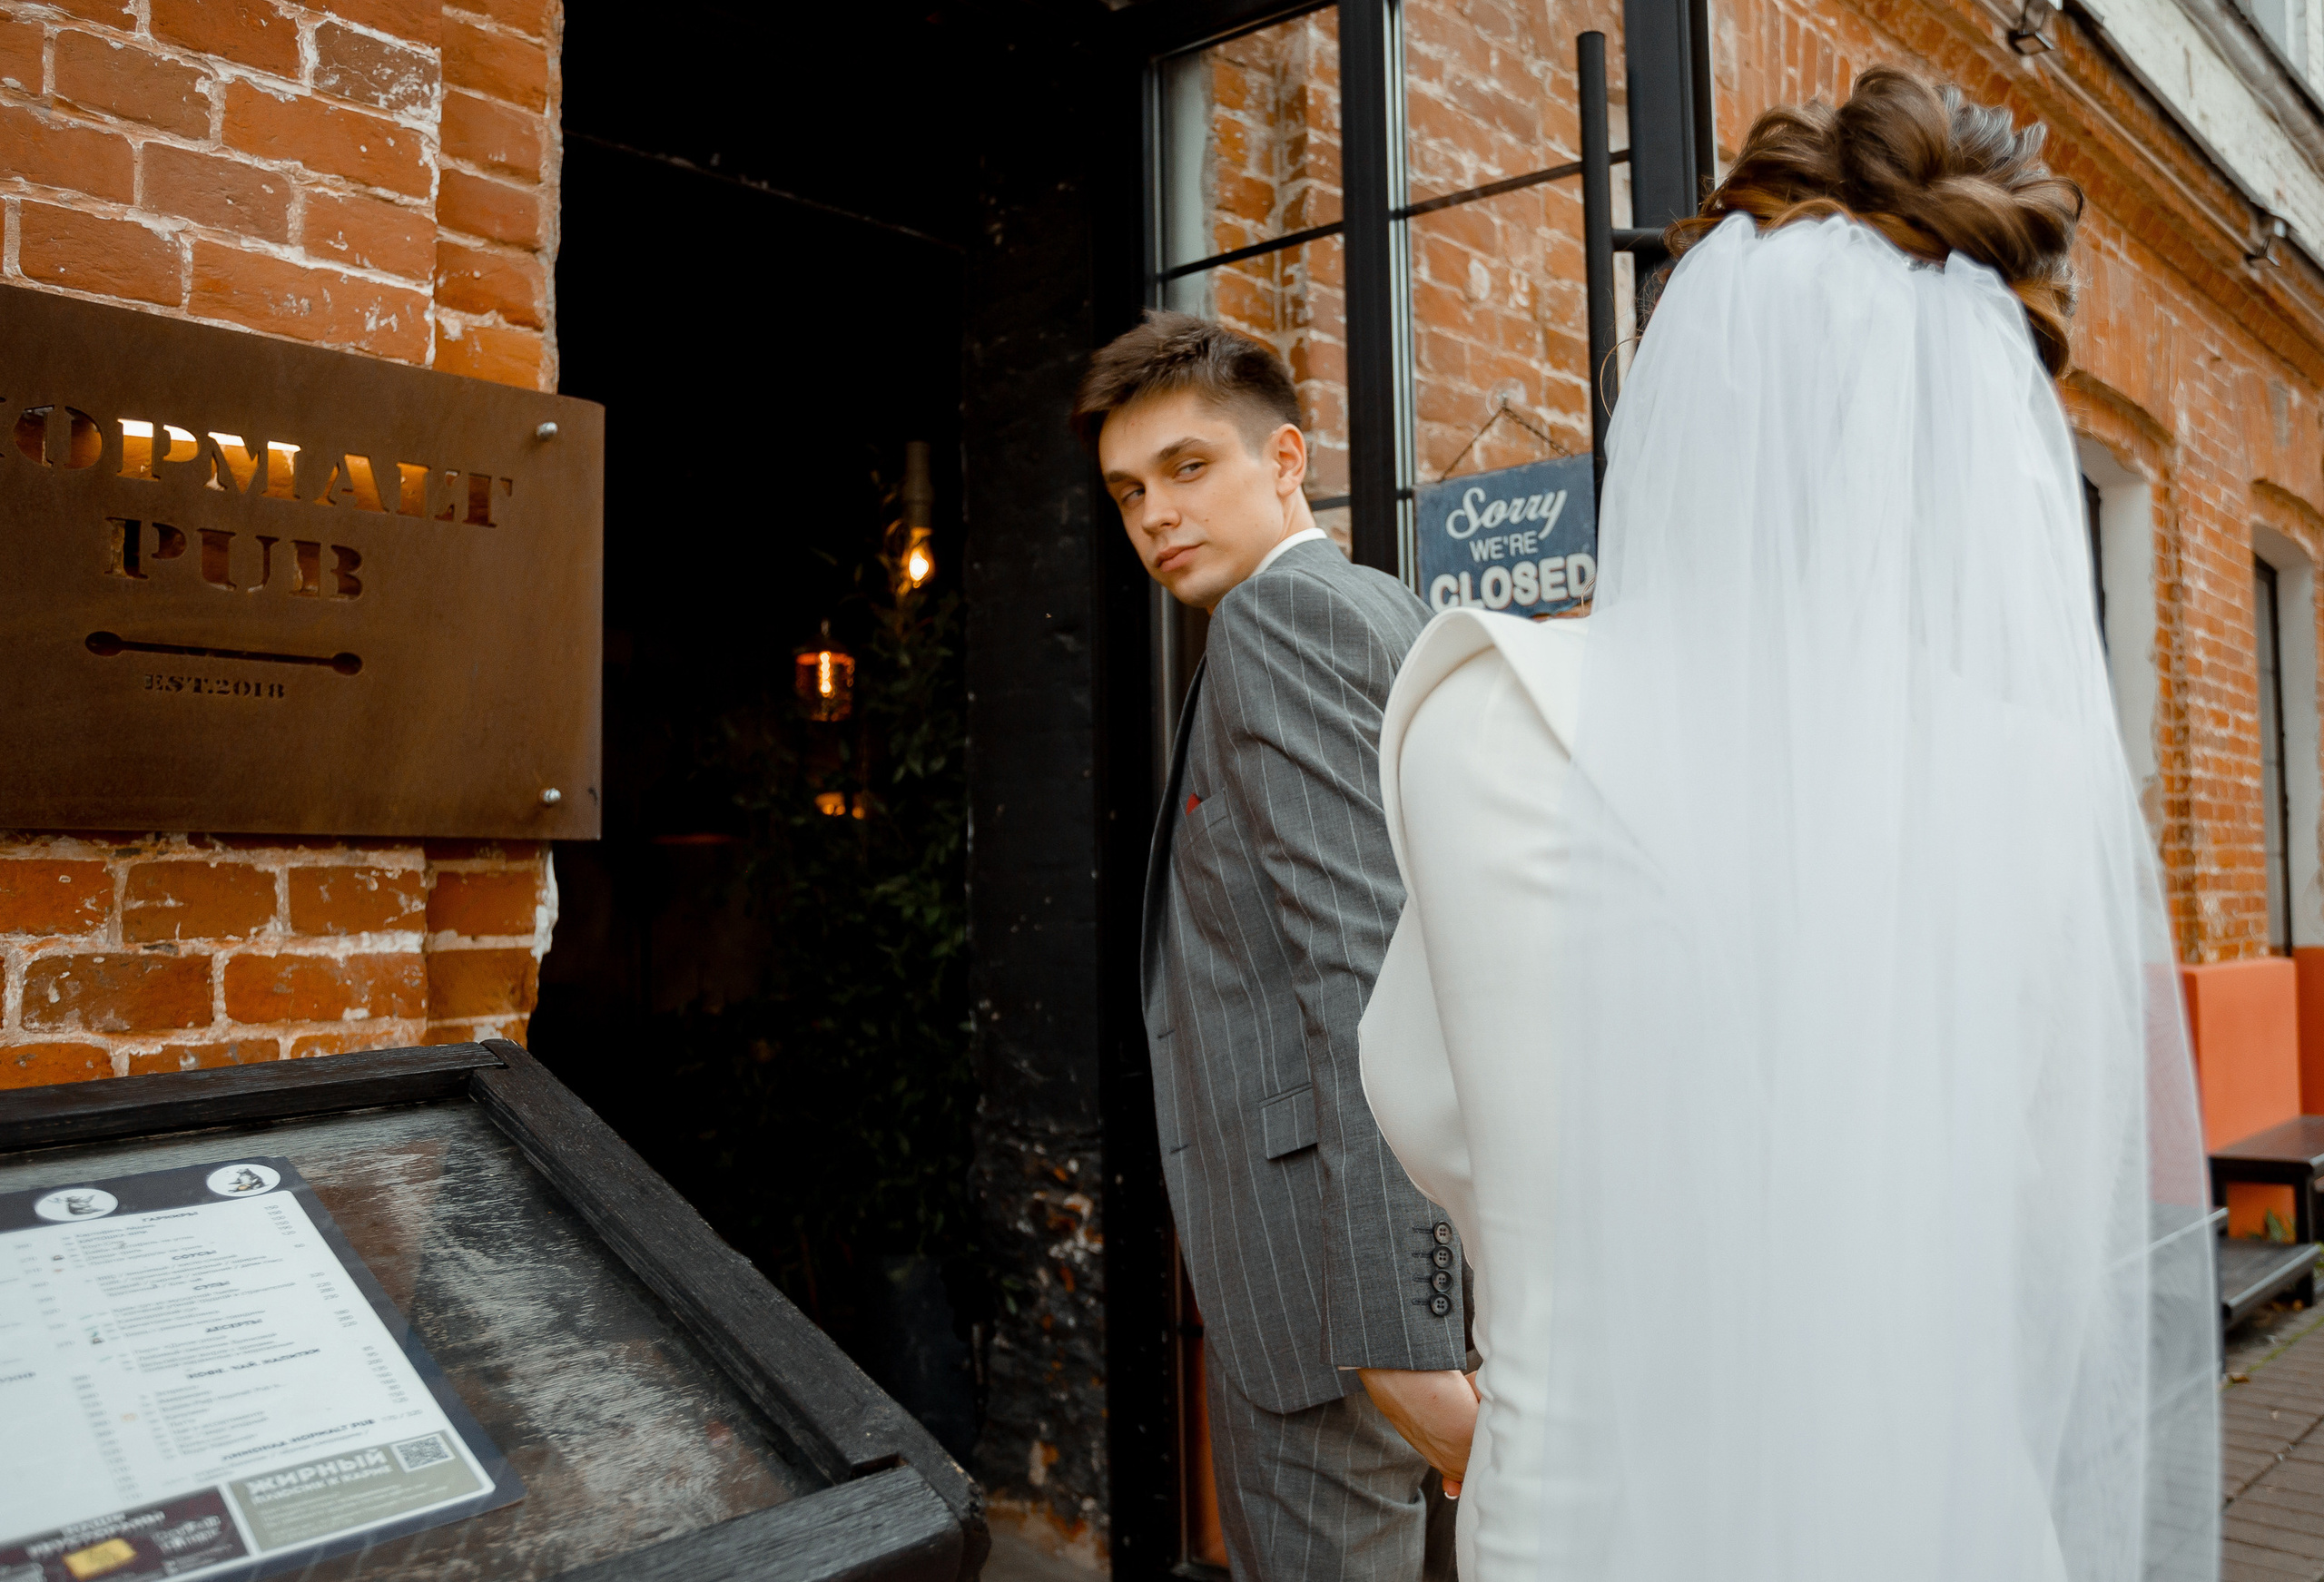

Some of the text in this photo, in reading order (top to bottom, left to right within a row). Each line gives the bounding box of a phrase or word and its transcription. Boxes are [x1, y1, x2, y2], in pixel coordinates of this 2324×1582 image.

[0, 396, 513, 527] OPMALT
[1445, 486, 1568, 540] Sorry
[103, 516, 365, 601] PUB
[1469, 530, 1539, 563] WE'RE
[1429, 552, 1596, 612] CLOSED
[172, 1250, 216, 1260] СОУСЫ
[246, 1449, 388, 1495] ЖИРНЫЙ
